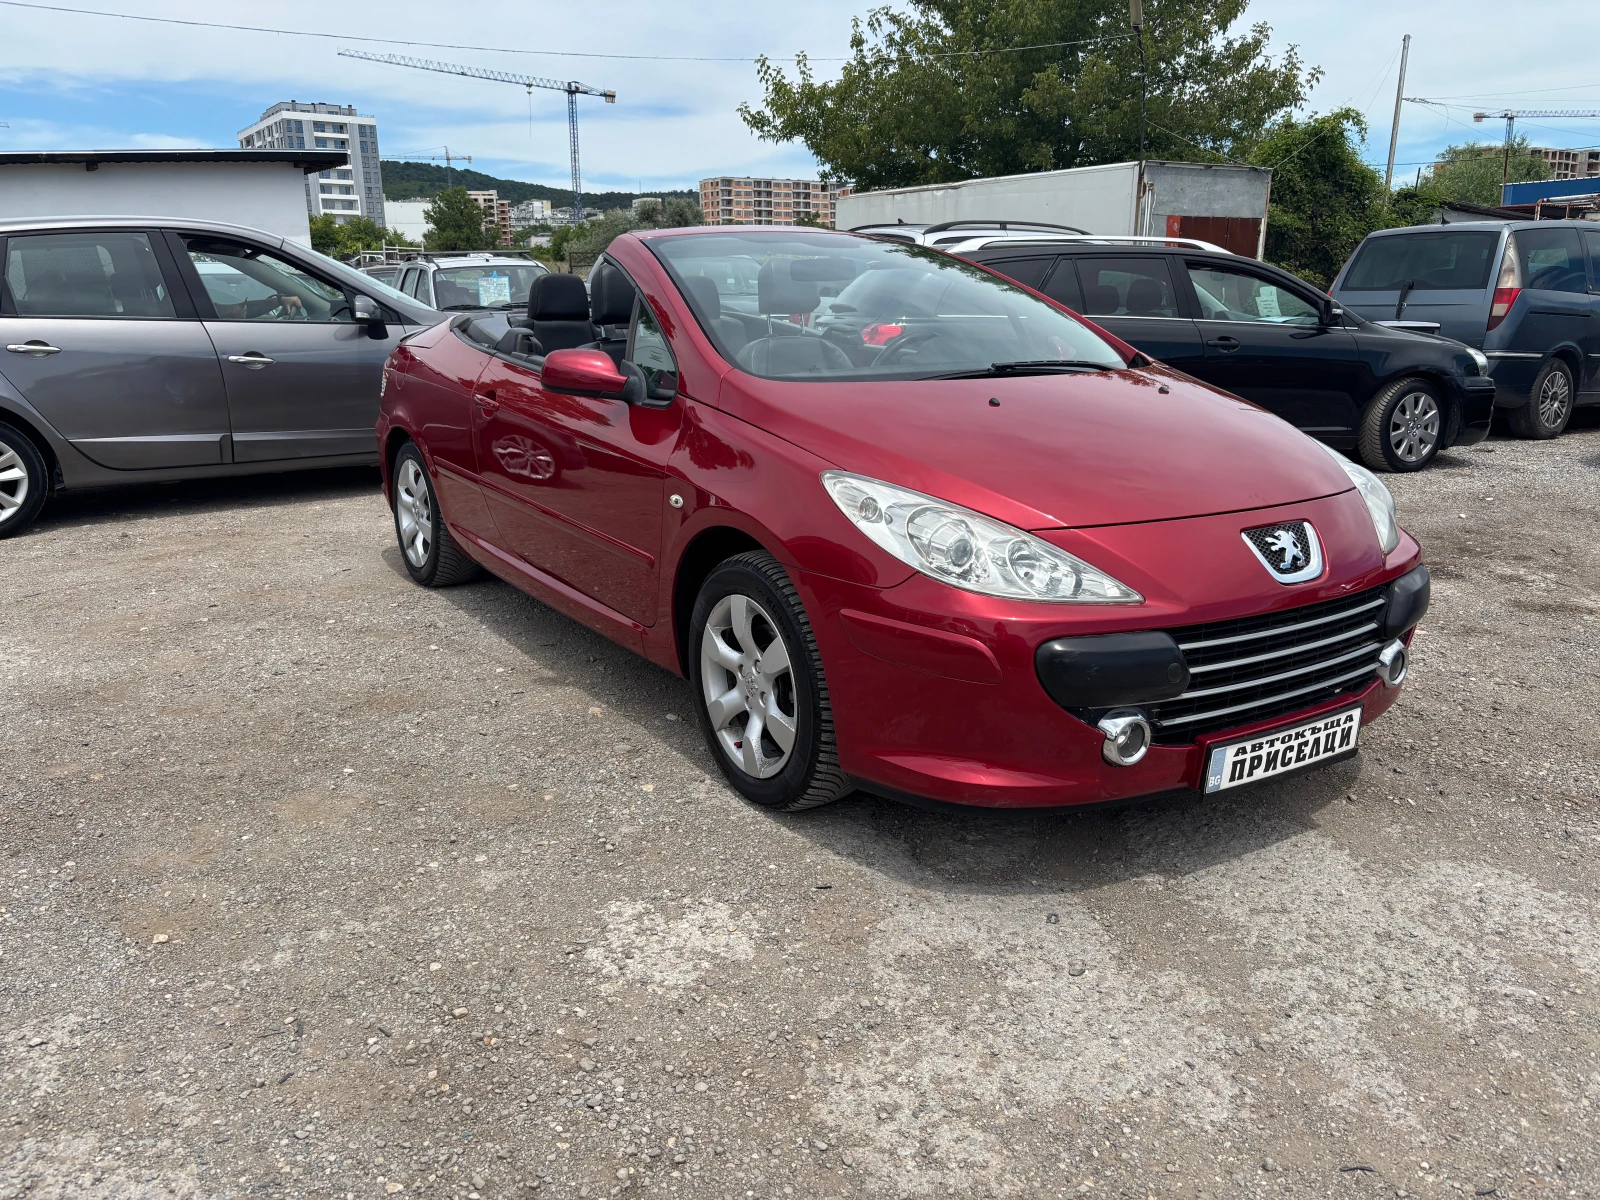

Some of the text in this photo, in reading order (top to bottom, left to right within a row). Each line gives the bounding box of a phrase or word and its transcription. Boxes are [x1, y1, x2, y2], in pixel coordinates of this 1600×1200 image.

[1229, 725, 1353, 783] ПРИСЕЛЦИ
[1233, 714, 1354, 758] АВТОКЪЩА
[1208, 775, 1221, 787] BG
